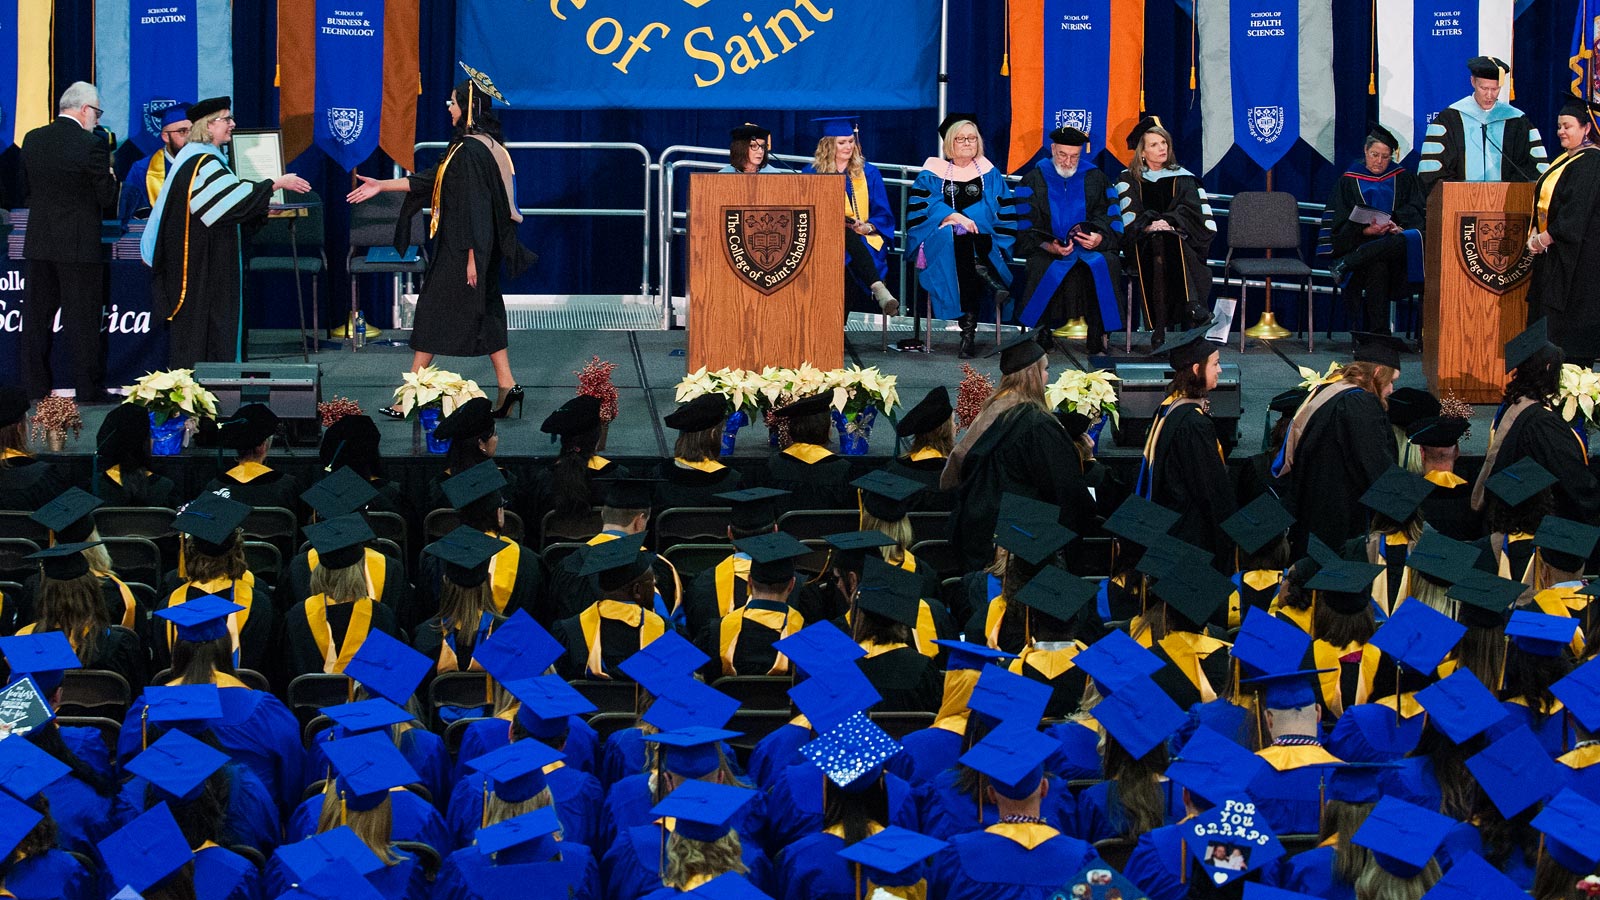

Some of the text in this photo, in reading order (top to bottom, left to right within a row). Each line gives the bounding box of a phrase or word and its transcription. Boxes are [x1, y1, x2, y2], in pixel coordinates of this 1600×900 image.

[141, 14, 186, 24] EDUCATION
[326, 17, 371, 27] BUSINESS &
[1250, 19, 1282, 27] HEALTH
[1434, 19, 1451, 27] ARTS
[321, 26, 375, 37] TECHNOLOGY
[1061, 22, 1092, 31] NURSING
[1431, 28, 1463, 36] LETTERS
[1247, 28, 1285, 37] SCIENCES
[586, 0, 834, 88] of Saint
[1464, 223, 1476, 241] The
[727, 213, 808, 287] The College of Saint Scholastica
[1464, 241, 1484, 275] College
[1482, 273, 1496, 283] of
[1497, 270, 1523, 286] Saint
[1224, 799, 1256, 815] FOR
[1220, 811, 1254, 827] YOU
[1194, 822, 1270, 845] GRAMPS
